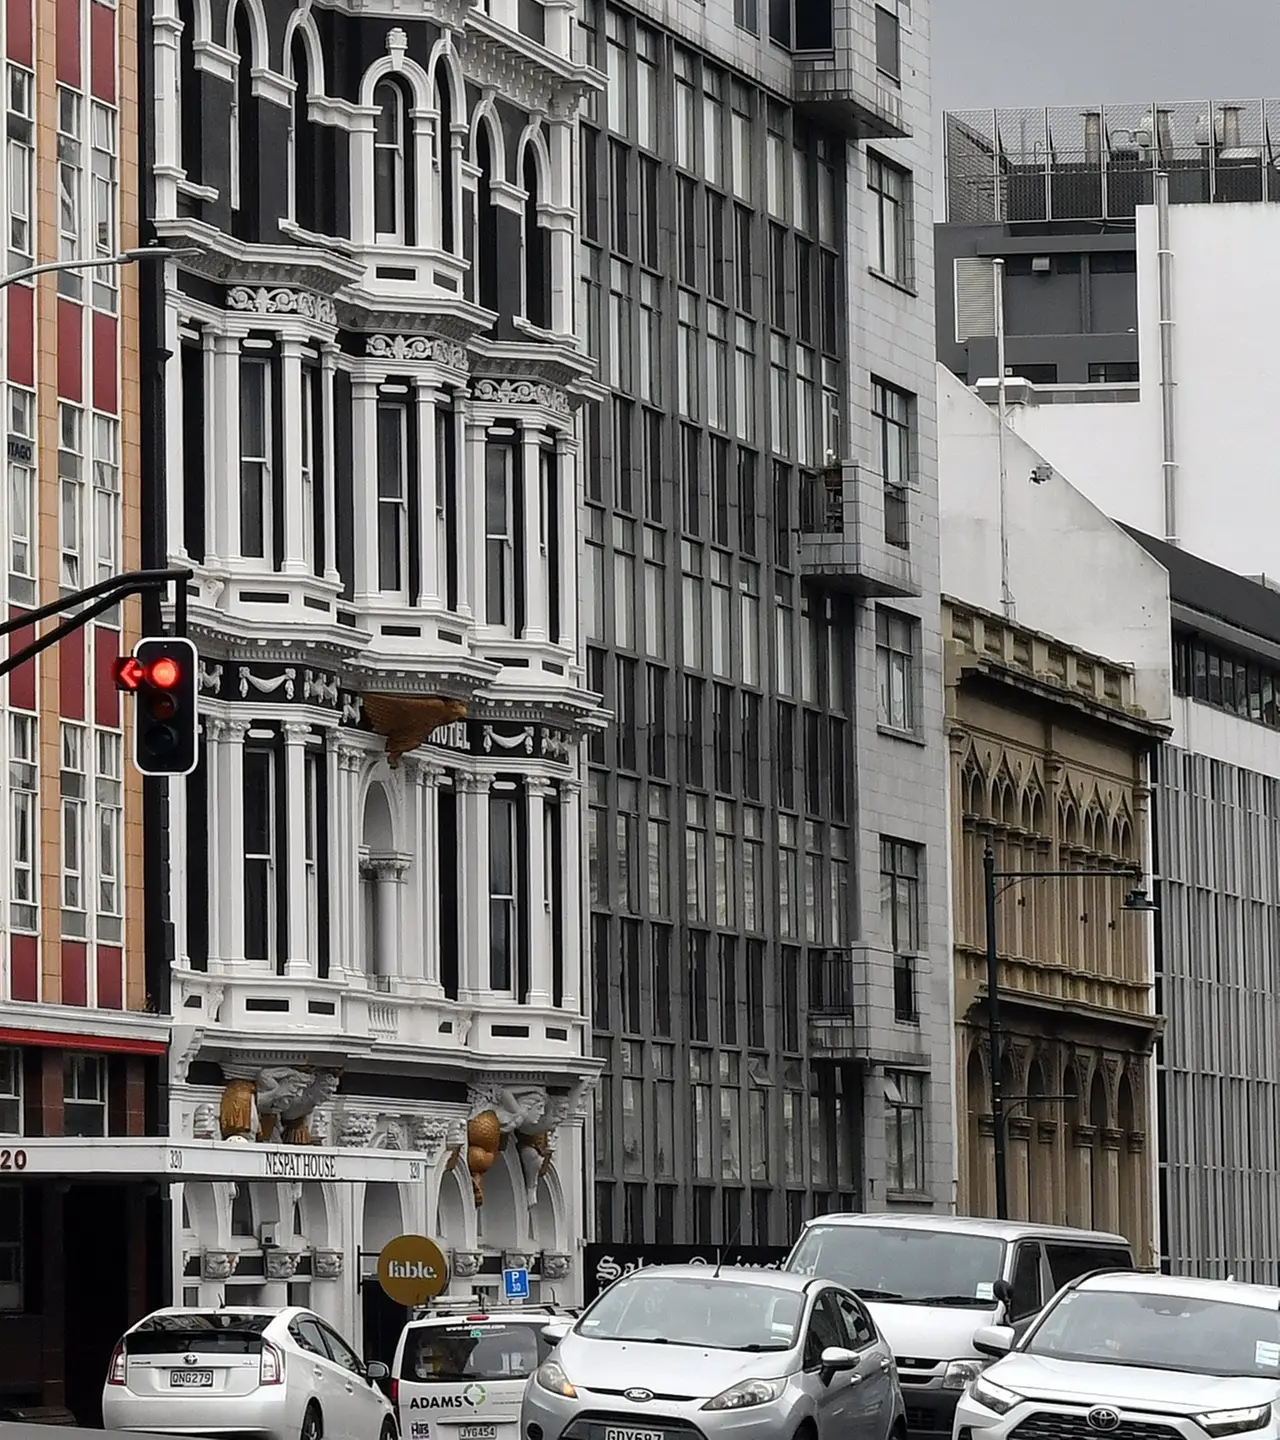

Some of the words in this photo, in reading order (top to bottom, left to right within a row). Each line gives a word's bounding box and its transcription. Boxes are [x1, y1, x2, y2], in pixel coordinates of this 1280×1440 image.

[170, 1150, 182, 1169] 320
[265, 1152, 302, 1177] NESPAT
[303, 1153, 336, 1178] HOUSE
[409, 1162, 420, 1179] 320
[388, 1261, 438, 1279] fable.
[511, 1272, 519, 1282] P
[172, 1373, 211, 1384] QNG279
[410, 1396, 463, 1409] ADAMS
[460, 1427, 494, 1438] JYG454
